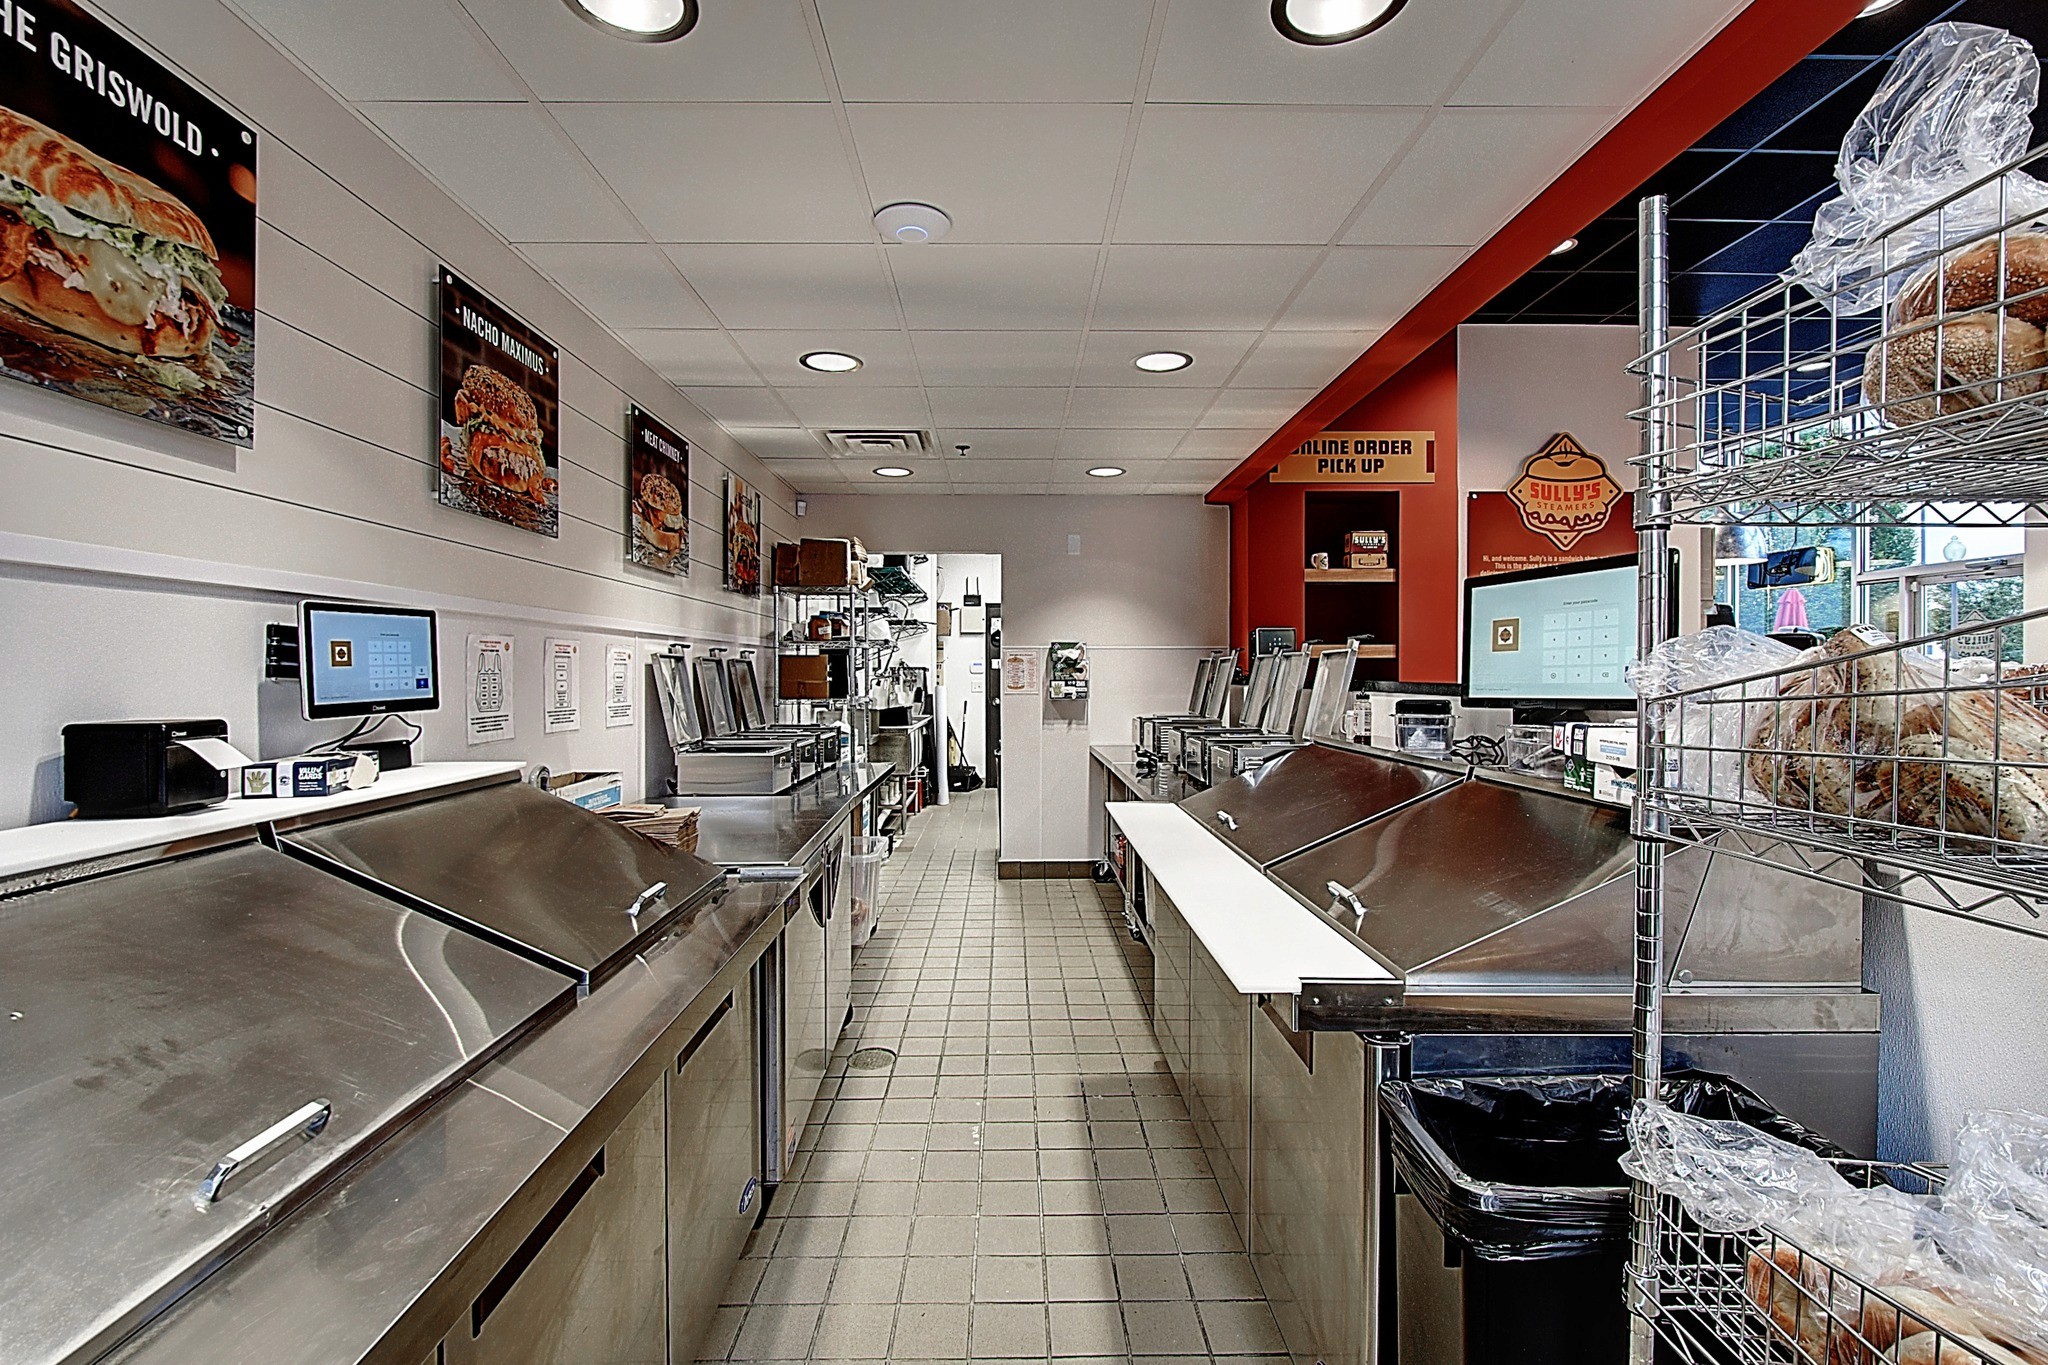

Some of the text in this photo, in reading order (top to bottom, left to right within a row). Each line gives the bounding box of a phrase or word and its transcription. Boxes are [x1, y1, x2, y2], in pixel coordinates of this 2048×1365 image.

[51, 31, 203, 156] GRISWOLD
[463, 305, 544, 375] NACHO MAXIMUS
[644, 428, 658, 450] MEAT
[1291, 439, 1412, 455] NLINE ORDER
[1318, 458, 1384, 473] PICK UP
[1530, 482, 1601, 502] SULLY'S
[1536, 501, 1595, 512] STEAMERS
[1354, 536, 1386, 544] SULLY'S
[1529, 555, 1547, 563] Sully's
